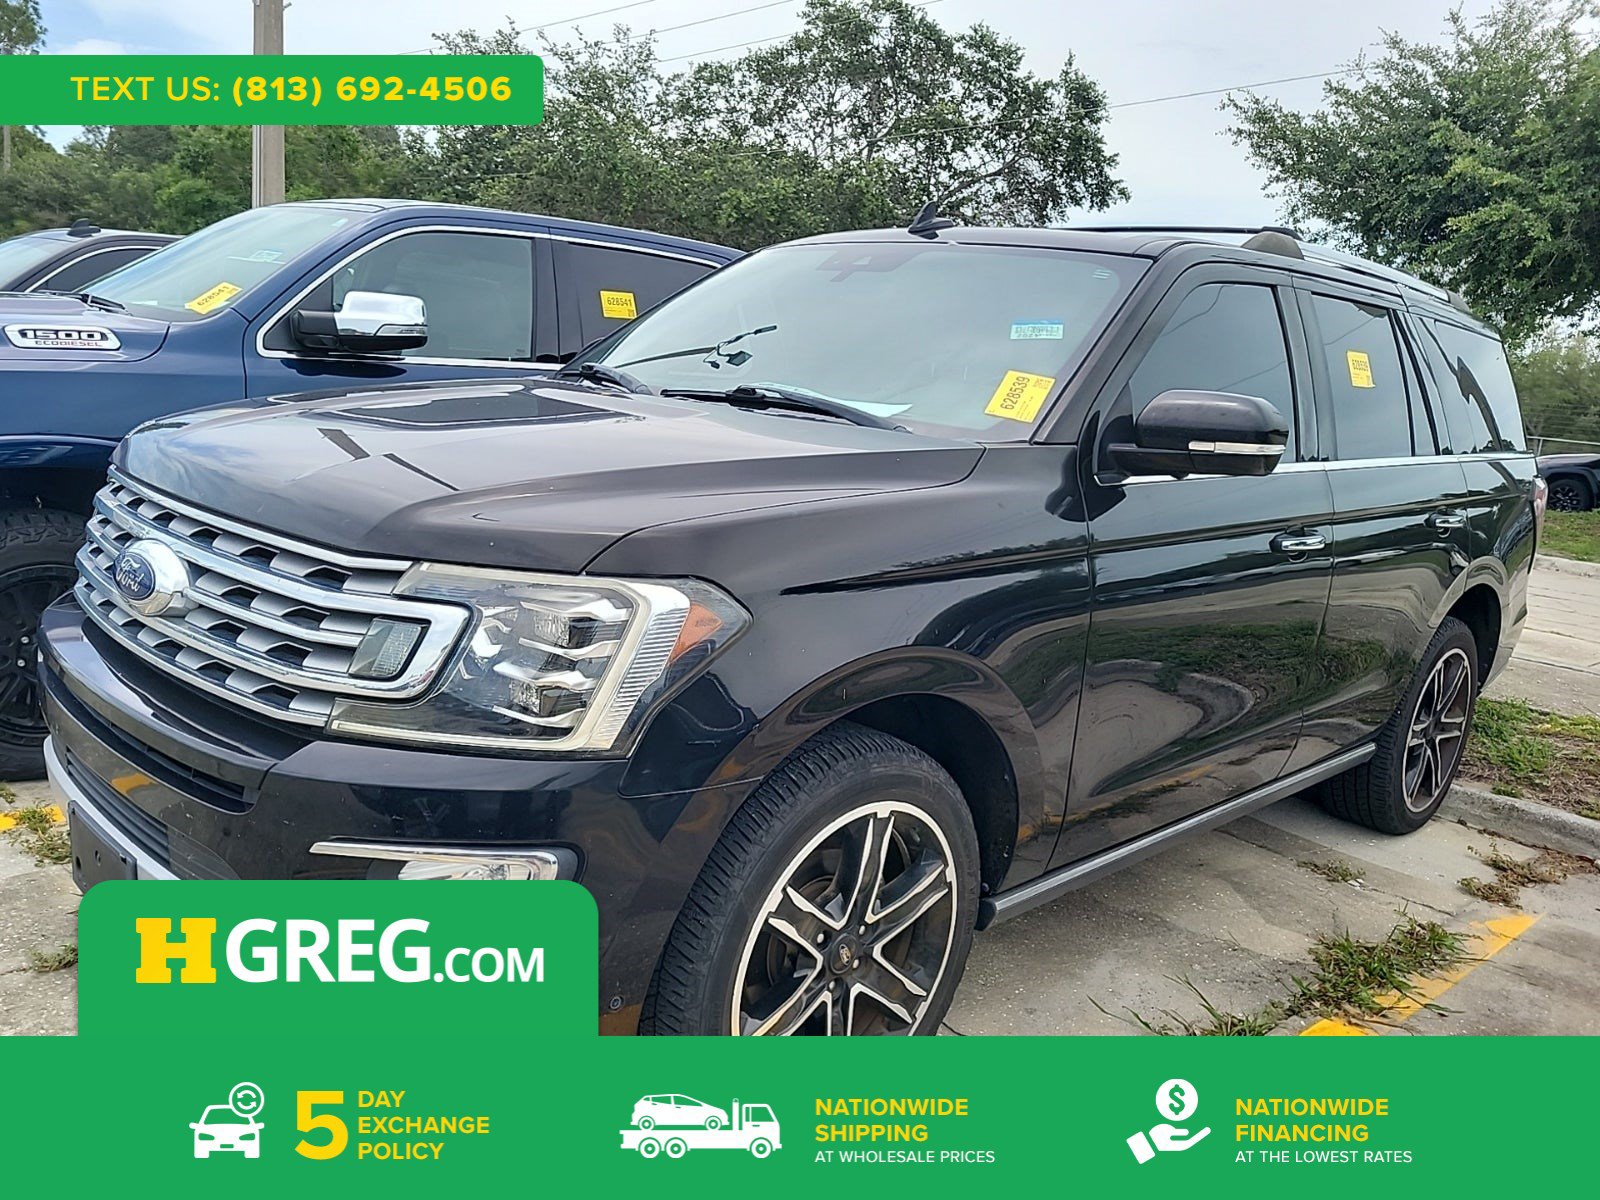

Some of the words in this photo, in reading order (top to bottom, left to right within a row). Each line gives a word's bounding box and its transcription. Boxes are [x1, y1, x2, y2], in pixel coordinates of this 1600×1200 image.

[20, 330, 102, 341] 1500
[1000, 376, 1030, 410] 628539
[116, 557, 145, 592] Ford
